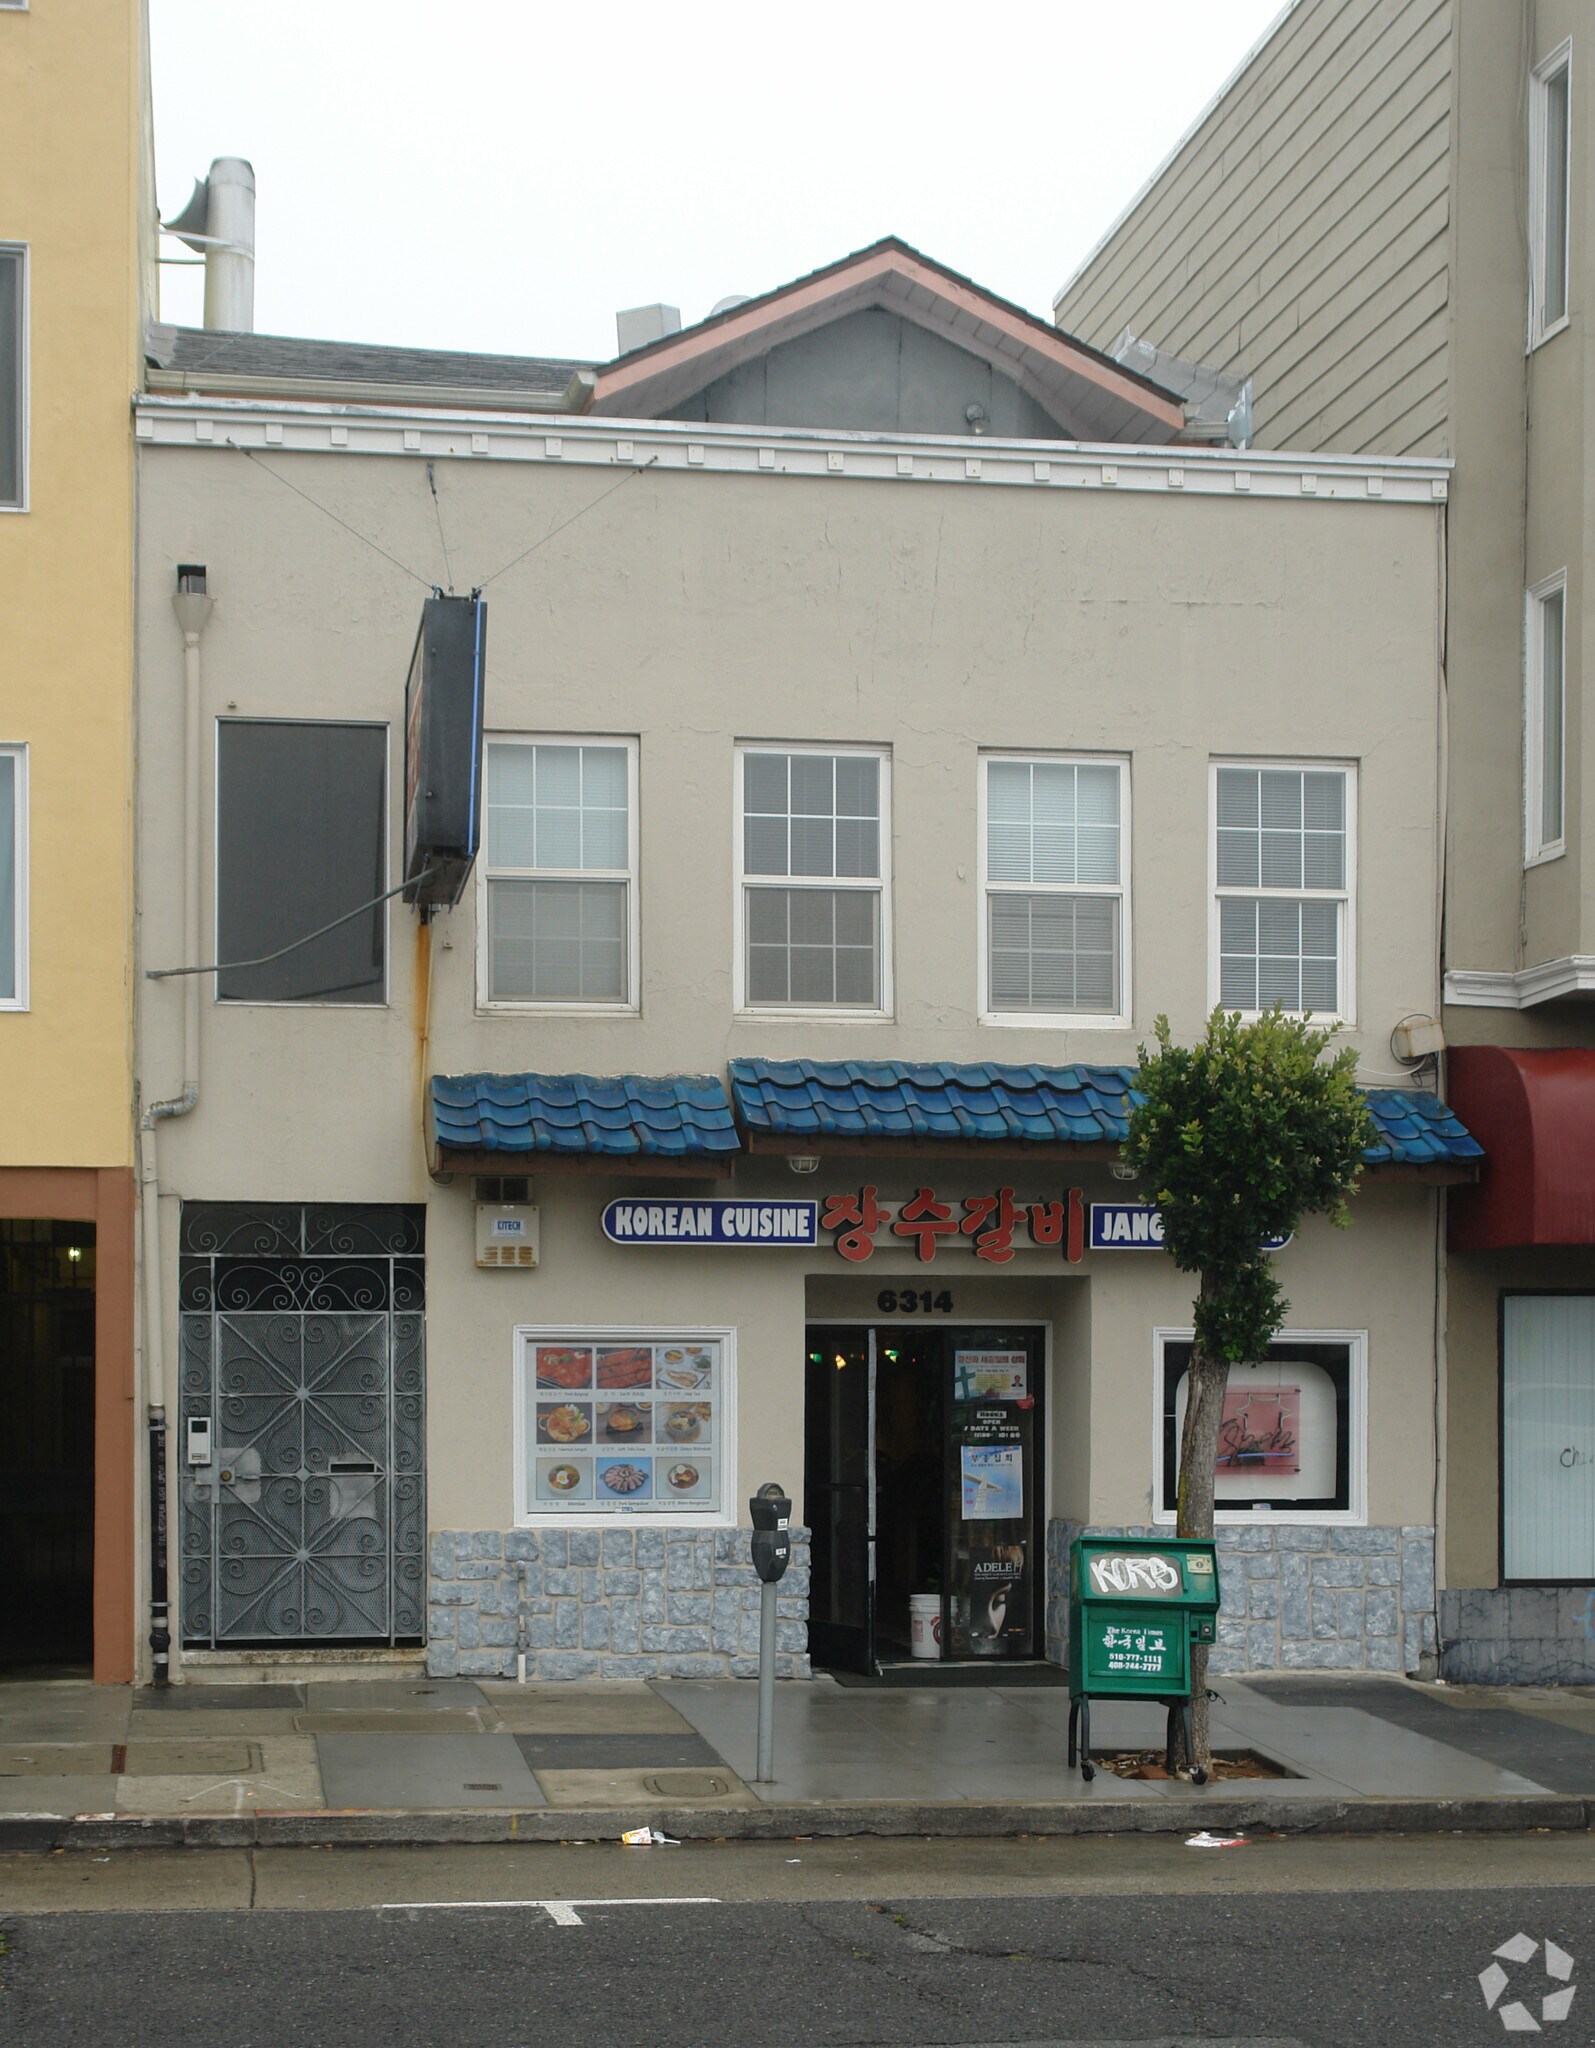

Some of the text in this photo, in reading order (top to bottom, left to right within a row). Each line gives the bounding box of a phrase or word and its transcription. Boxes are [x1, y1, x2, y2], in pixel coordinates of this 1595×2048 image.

[615, 1206, 811, 1238] KOREAN CUISINE
[820, 1184, 1085, 1264] 장수갈비
[1101, 1212, 1165, 1241] JANG
[877, 1289, 954, 1313] 6314
[974, 1562, 1013, 1573] ADELE
[1102, 1634, 1167, 1652] 한국일보
[1106, 1626, 1164, 1636] The Korea Times
